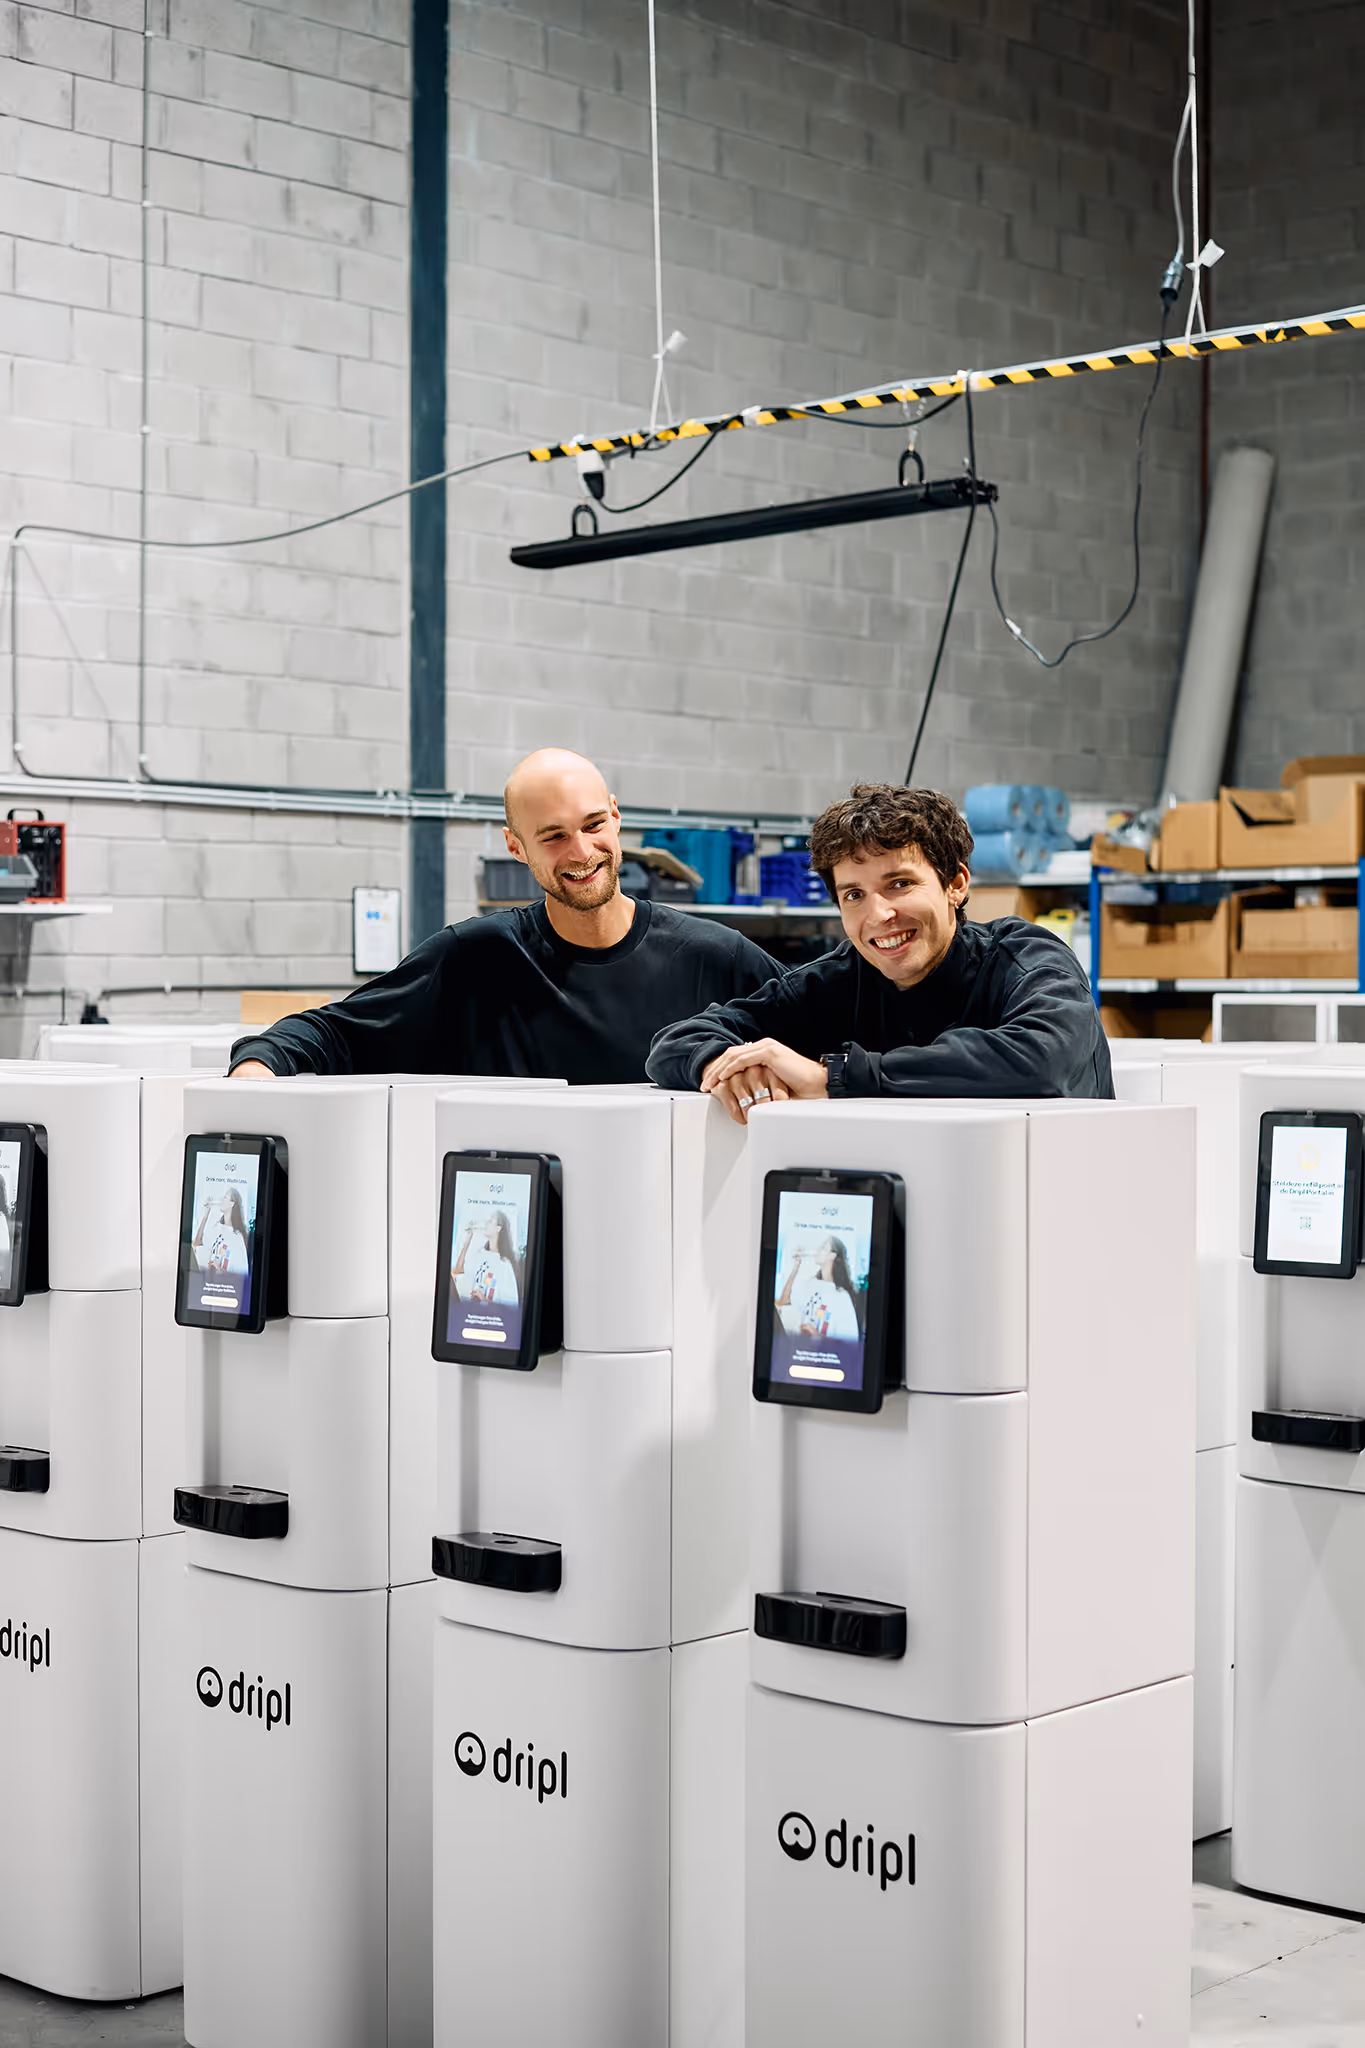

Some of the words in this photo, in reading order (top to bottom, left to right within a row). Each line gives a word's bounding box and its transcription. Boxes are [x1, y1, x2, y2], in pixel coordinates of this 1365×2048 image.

[0, 1618, 50, 1672] dripl
[229, 1671, 291, 1731] dripl
[493, 1738, 567, 1803] dripl
[825, 1818, 916, 1891] dripl
